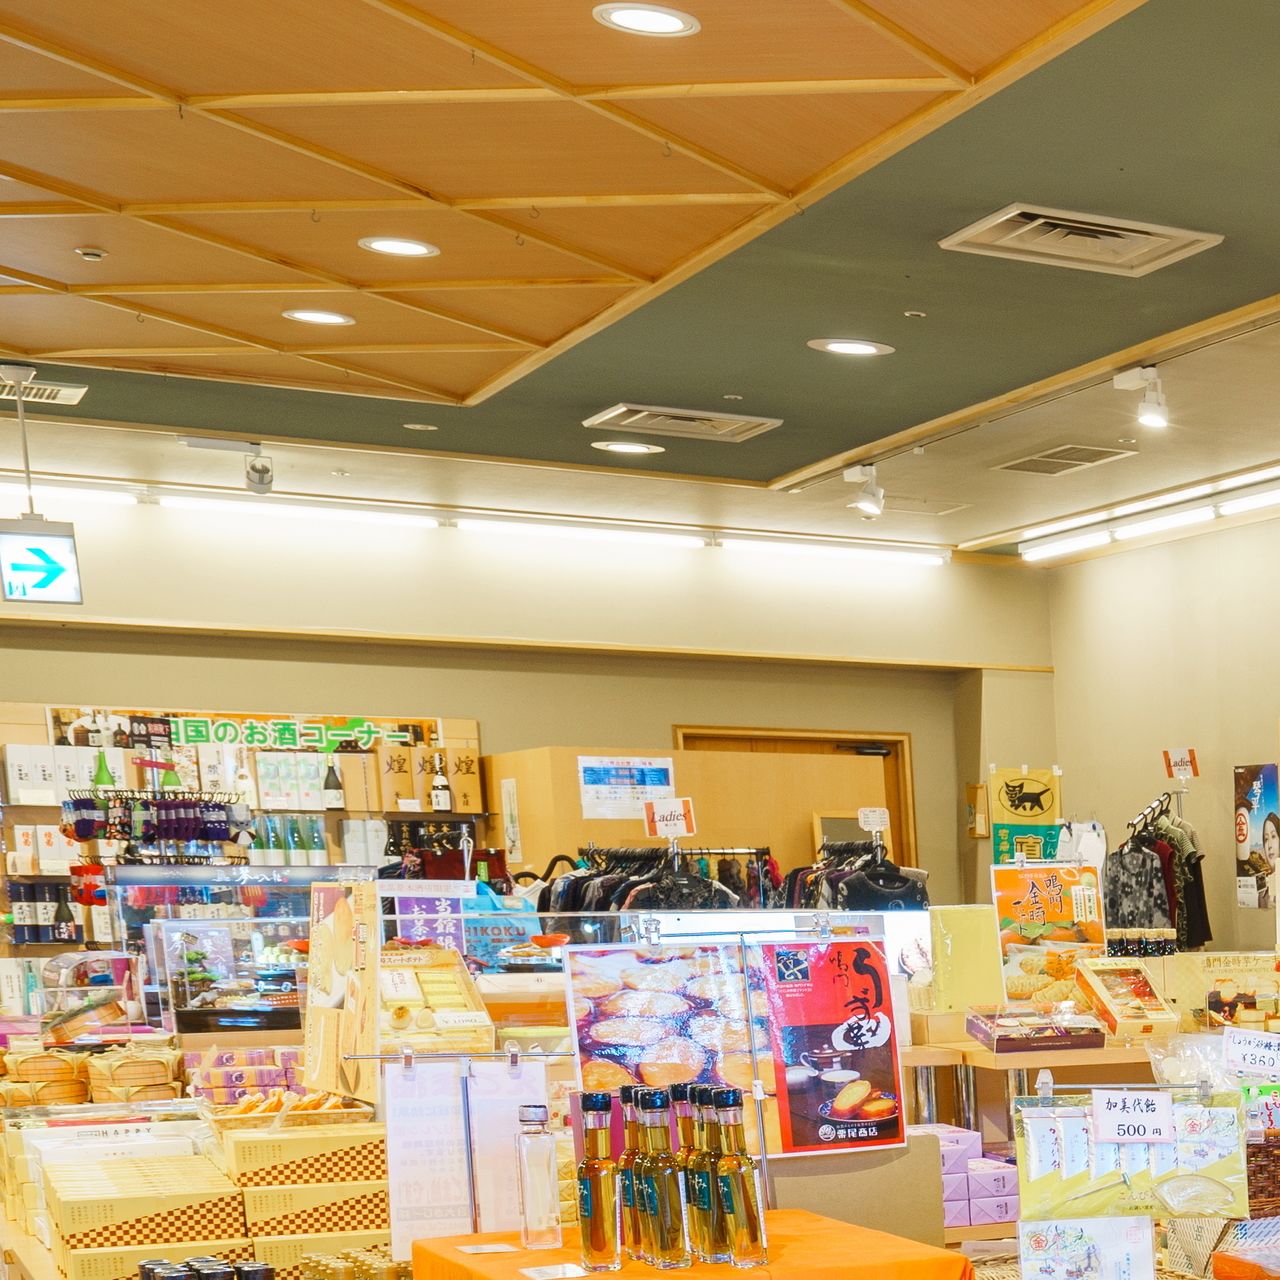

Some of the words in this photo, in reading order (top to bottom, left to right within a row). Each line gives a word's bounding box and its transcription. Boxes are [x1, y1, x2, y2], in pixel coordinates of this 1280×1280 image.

[651, 810, 690, 825] Ladies'
[463, 926, 526, 937] HIKOKU
[1242, 1053, 1275, 1067] ¥360
[1105, 1097, 1157, 1114] 加美代飴
[1117, 1124, 1147, 1138] 500
[1152, 1127, 1162, 1137] 円
